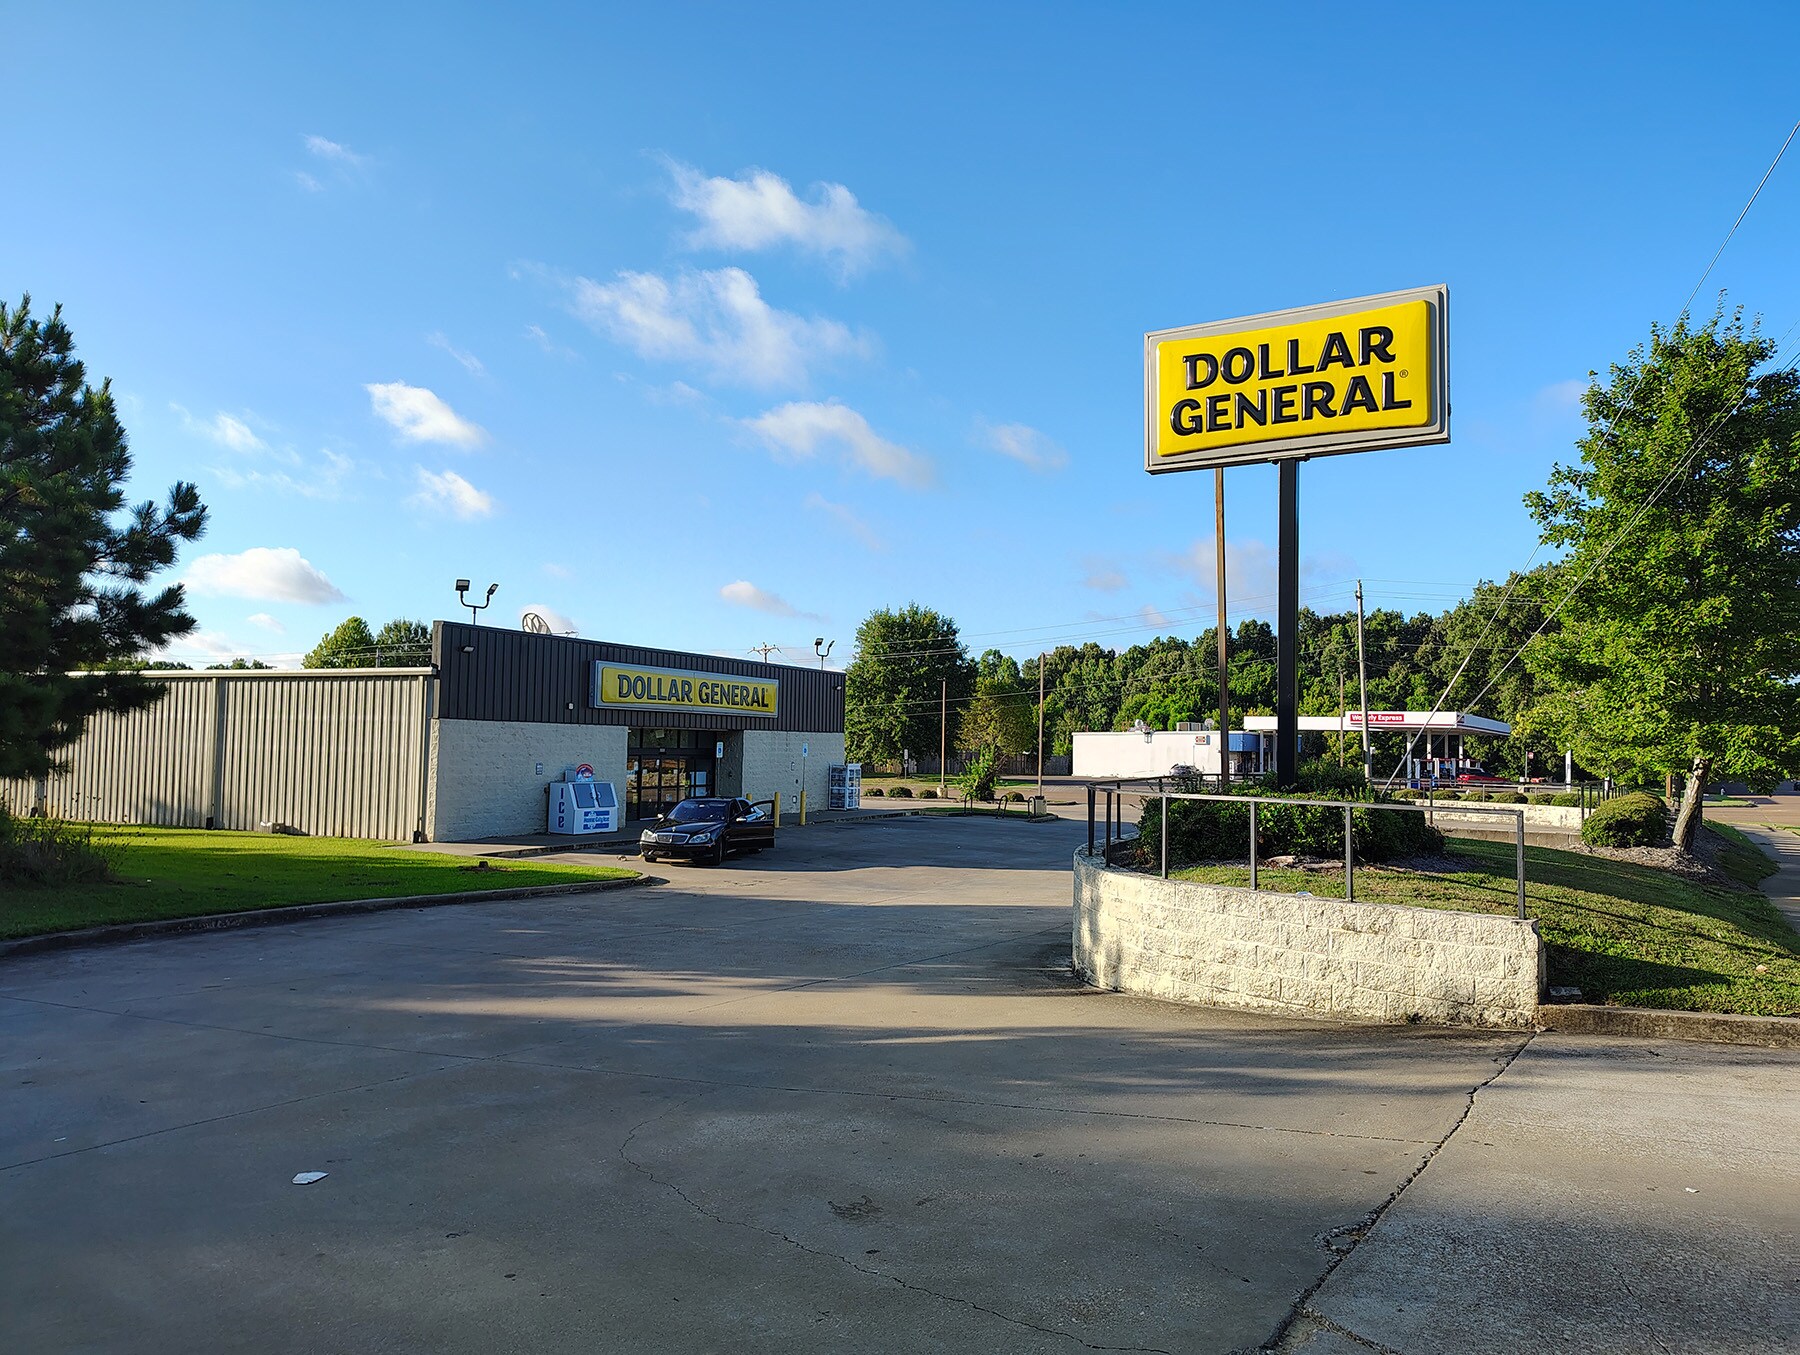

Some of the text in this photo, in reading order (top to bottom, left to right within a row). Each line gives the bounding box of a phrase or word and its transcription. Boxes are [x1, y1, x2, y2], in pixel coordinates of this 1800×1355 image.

[1183, 326, 1396, 390] DOLLAR
[1170, 371, 1412, 436] GENERAL
[618, 674, 769, 708] DOLLAR GENERAL
[1378, 714, 1403, 722] Express
